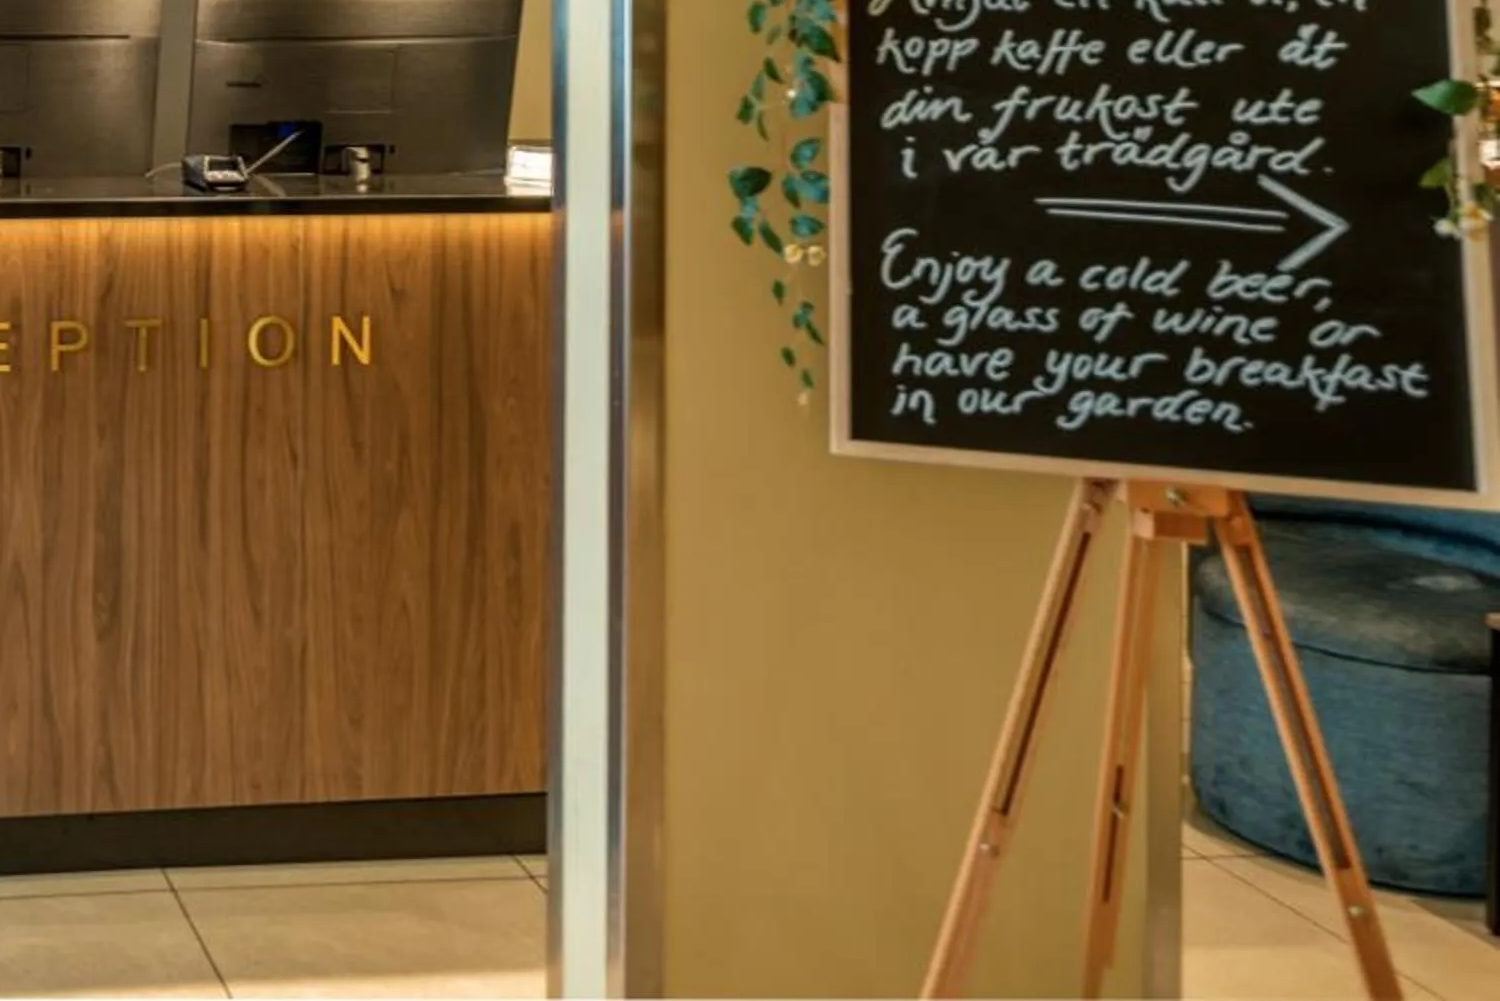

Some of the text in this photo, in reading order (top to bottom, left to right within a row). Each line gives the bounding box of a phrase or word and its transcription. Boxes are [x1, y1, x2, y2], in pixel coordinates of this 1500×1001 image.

[876, 27, 979, 76] kopp
[990, 29, 1106, 75] kaffe
[1128, 28, 1245, 68] eller
[881, 84, 1324, 145] din frukost ute
[901, 126, 1334, 193] i vår trädgård.
[880, 228, 1332, 312] Enjoy a cold beer,
[891, 301, 1382, 347] a glass of wine or
[891, 343, 1429, 412] have your breakfast
[890, 385, 1255, 432] in our garden.
